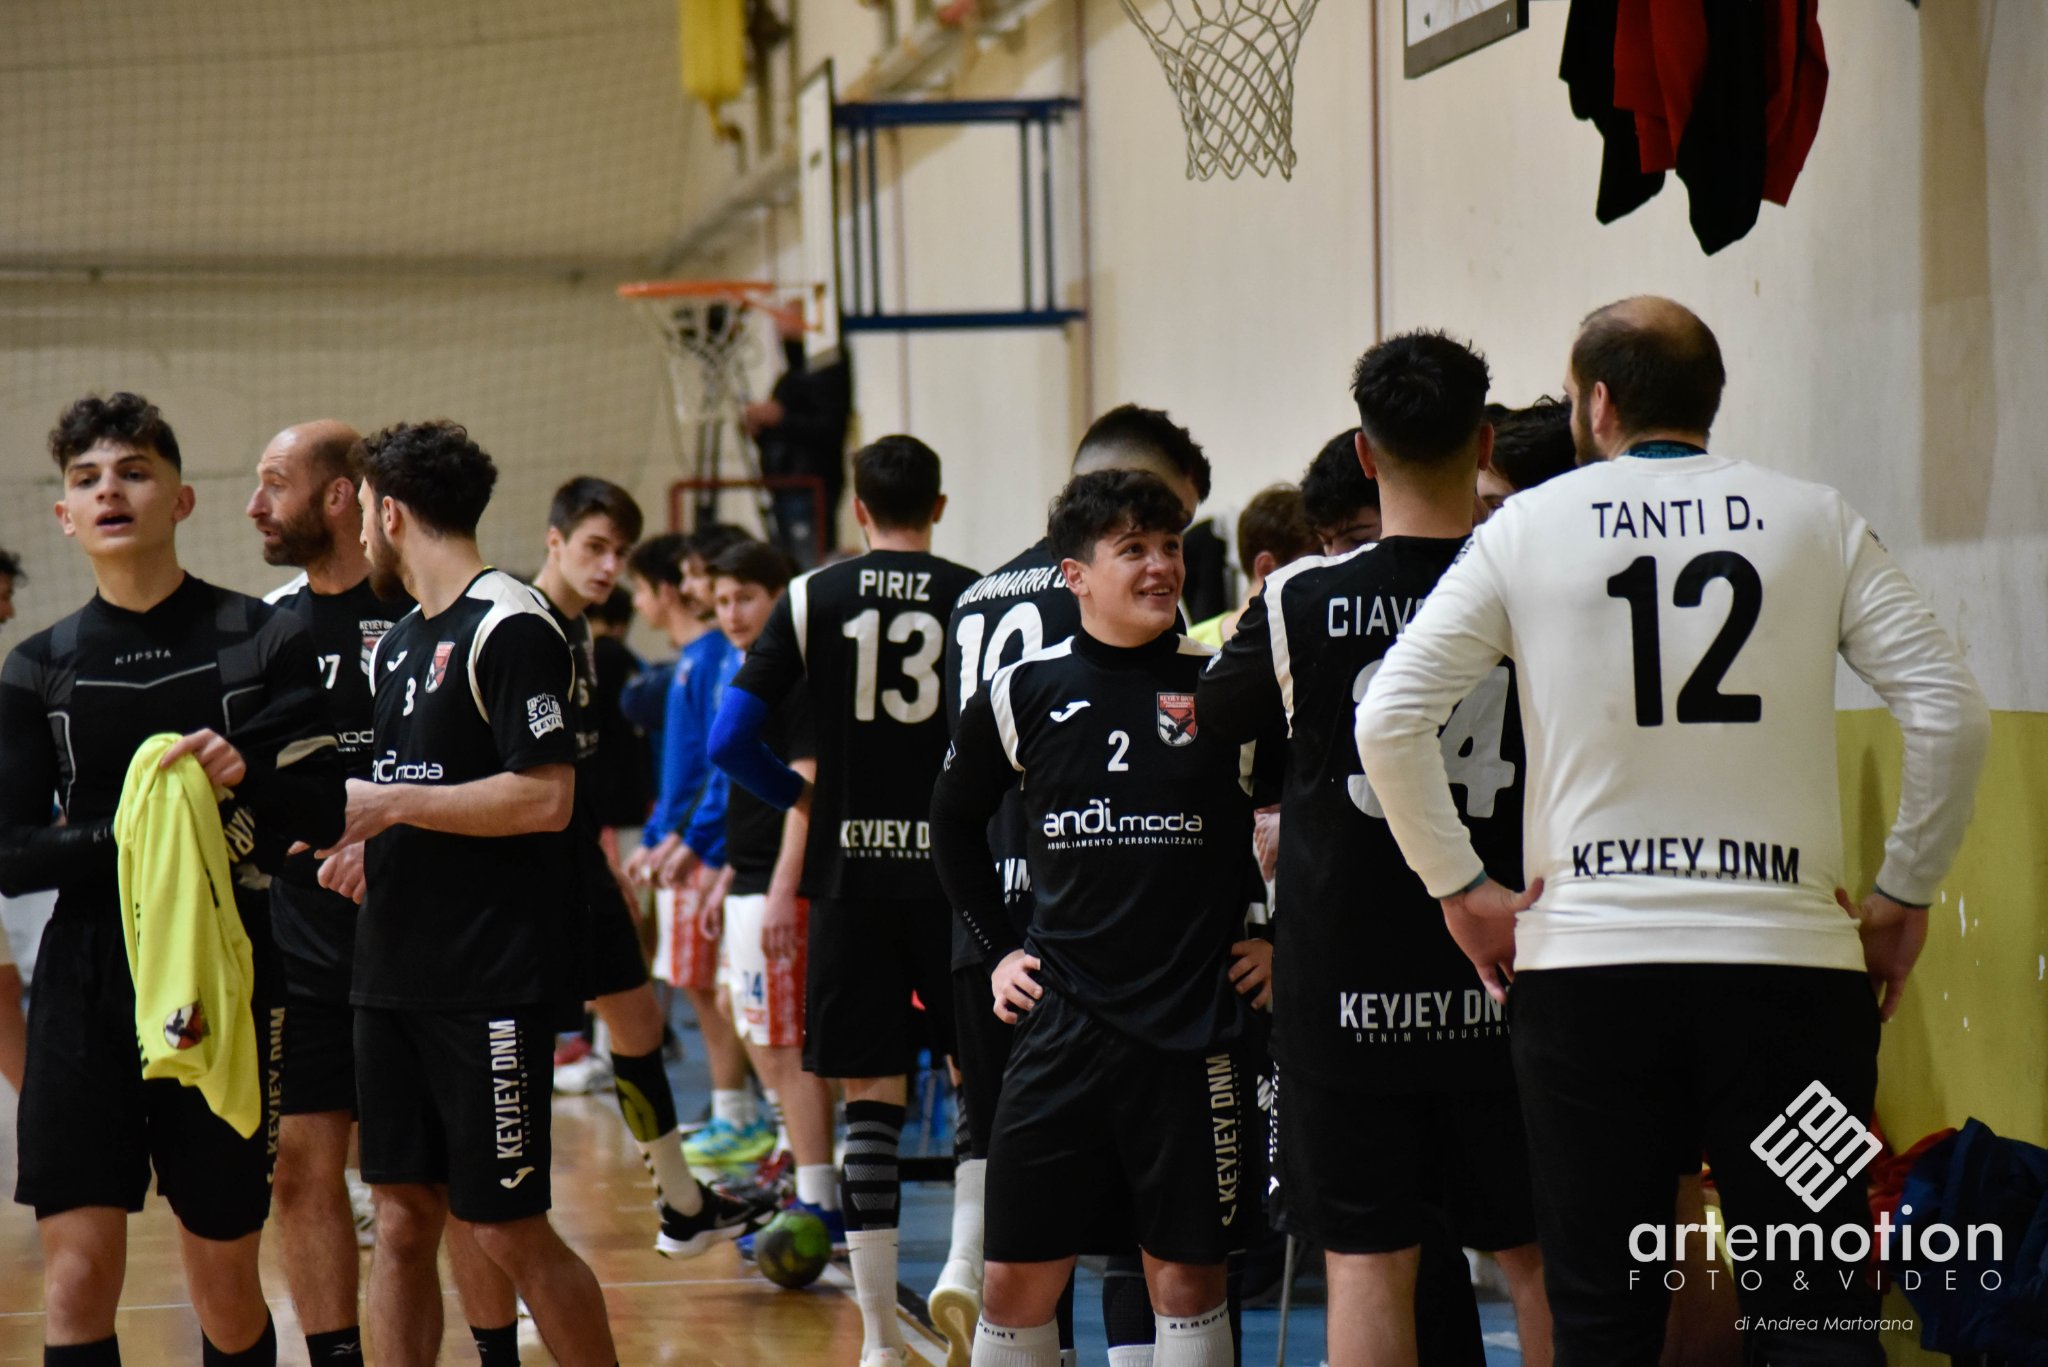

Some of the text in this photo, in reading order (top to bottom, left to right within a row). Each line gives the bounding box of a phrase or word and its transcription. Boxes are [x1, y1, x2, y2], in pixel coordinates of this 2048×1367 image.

[1591, 495, 1764, 538] TANTI D.
[859, 569, 932, 601] PIRIZ
[1328, 596, 1425, 638] CIAV
[115, 649, 172, 665] KIPSTA
[1606, 550, 1763, 727] 12
[842, 608, 944, 724] 13
[1107, 730, 1131, 772] 2
[839, 819, 911, 849] KEYJEY
[1043, 797, 1204, 838] andi moda
[1047, 836, 1204, 850] ABBIGLIAMENTO PERSONALIZZATO
[1572, 837, 1800, 885] KEYJEY DNM
[1340, 990, 1454, 1030] KEYJEY
[1356, 1032, 1412, 1044] DENIM
[489, 1019, 523, 1159] KEYJEY DNM
[1205, 1053, 1237, 1203] KEYJEY DNM
